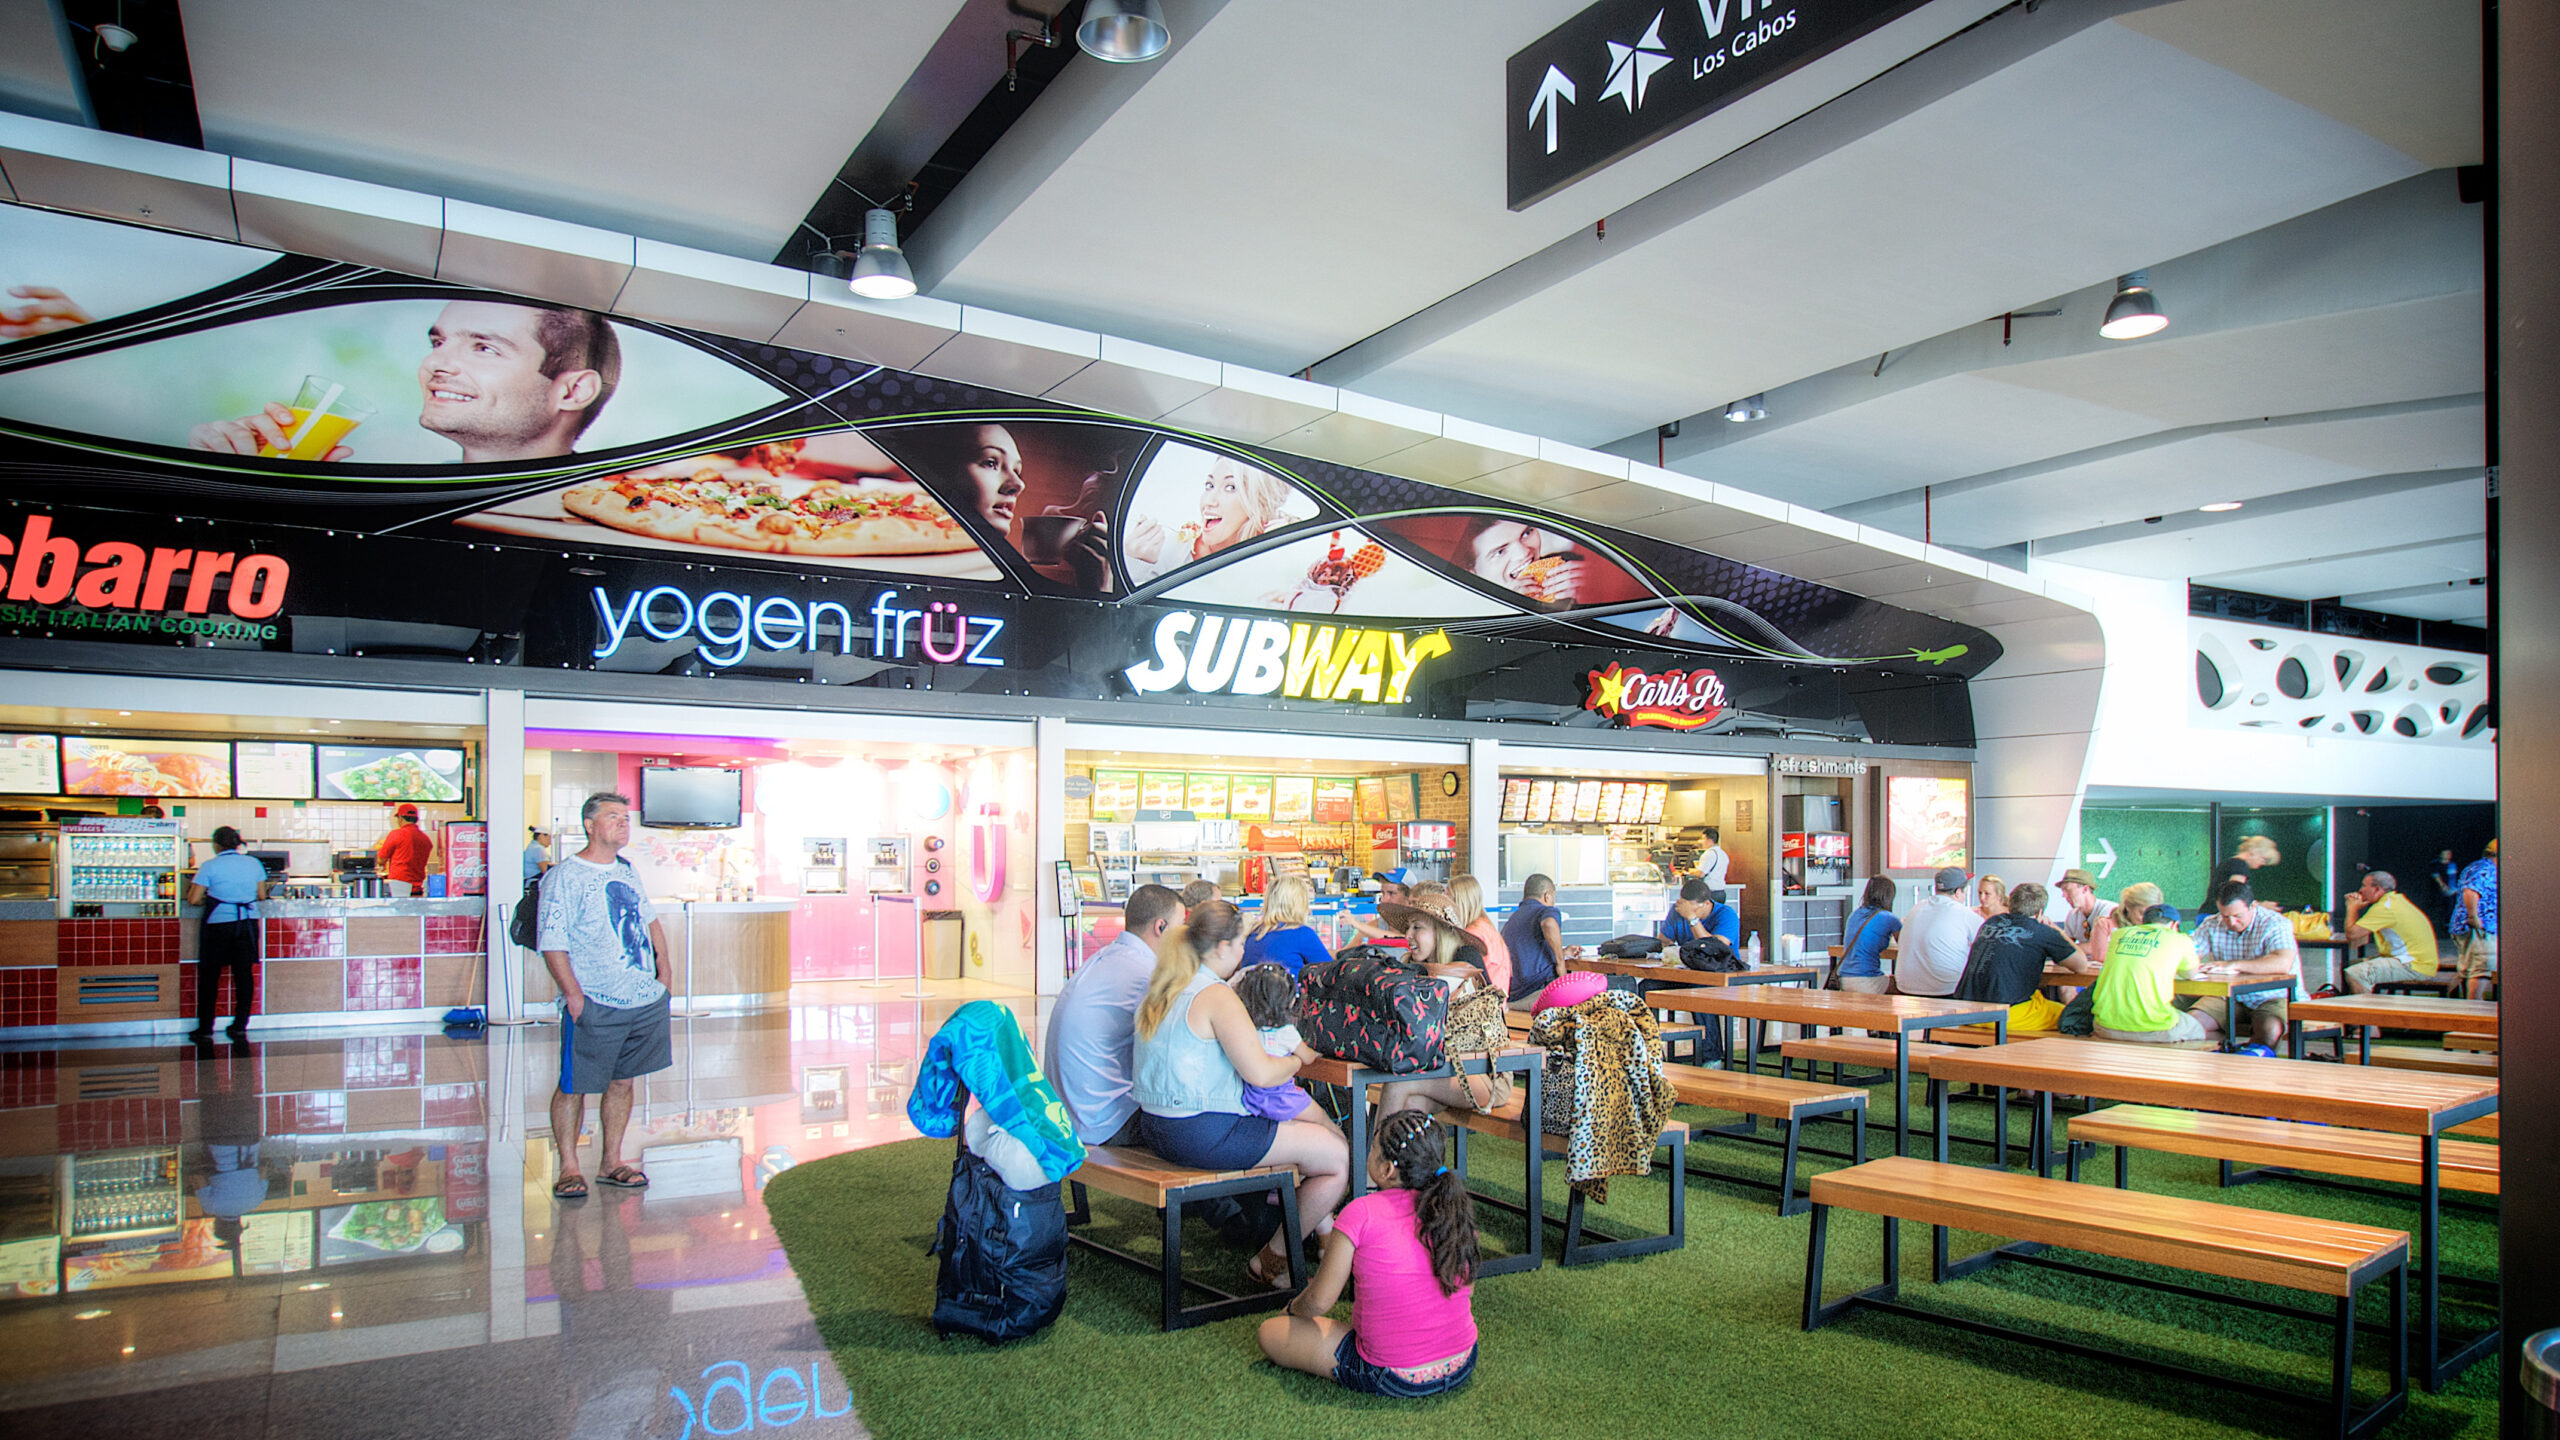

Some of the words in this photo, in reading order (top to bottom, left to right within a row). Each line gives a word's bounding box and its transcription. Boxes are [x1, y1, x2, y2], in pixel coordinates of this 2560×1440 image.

[1693, 48, 1726, 80] Los
[1731, 8, 1797, 57] Cabos
[0, 514, 290, 619] barro
[48, 610, 151, 632] ITALIAN
[160, 618, 278, 640] COOKING
[592, 586, 852, 667] yogen
[1124, 610, 1453, 704] SUBWAY
[1620, 673, 1690, 710] Carl's
[1688, 675, 1728, 711] Jr.
[1771, 756, 1867, 774] refreshments
